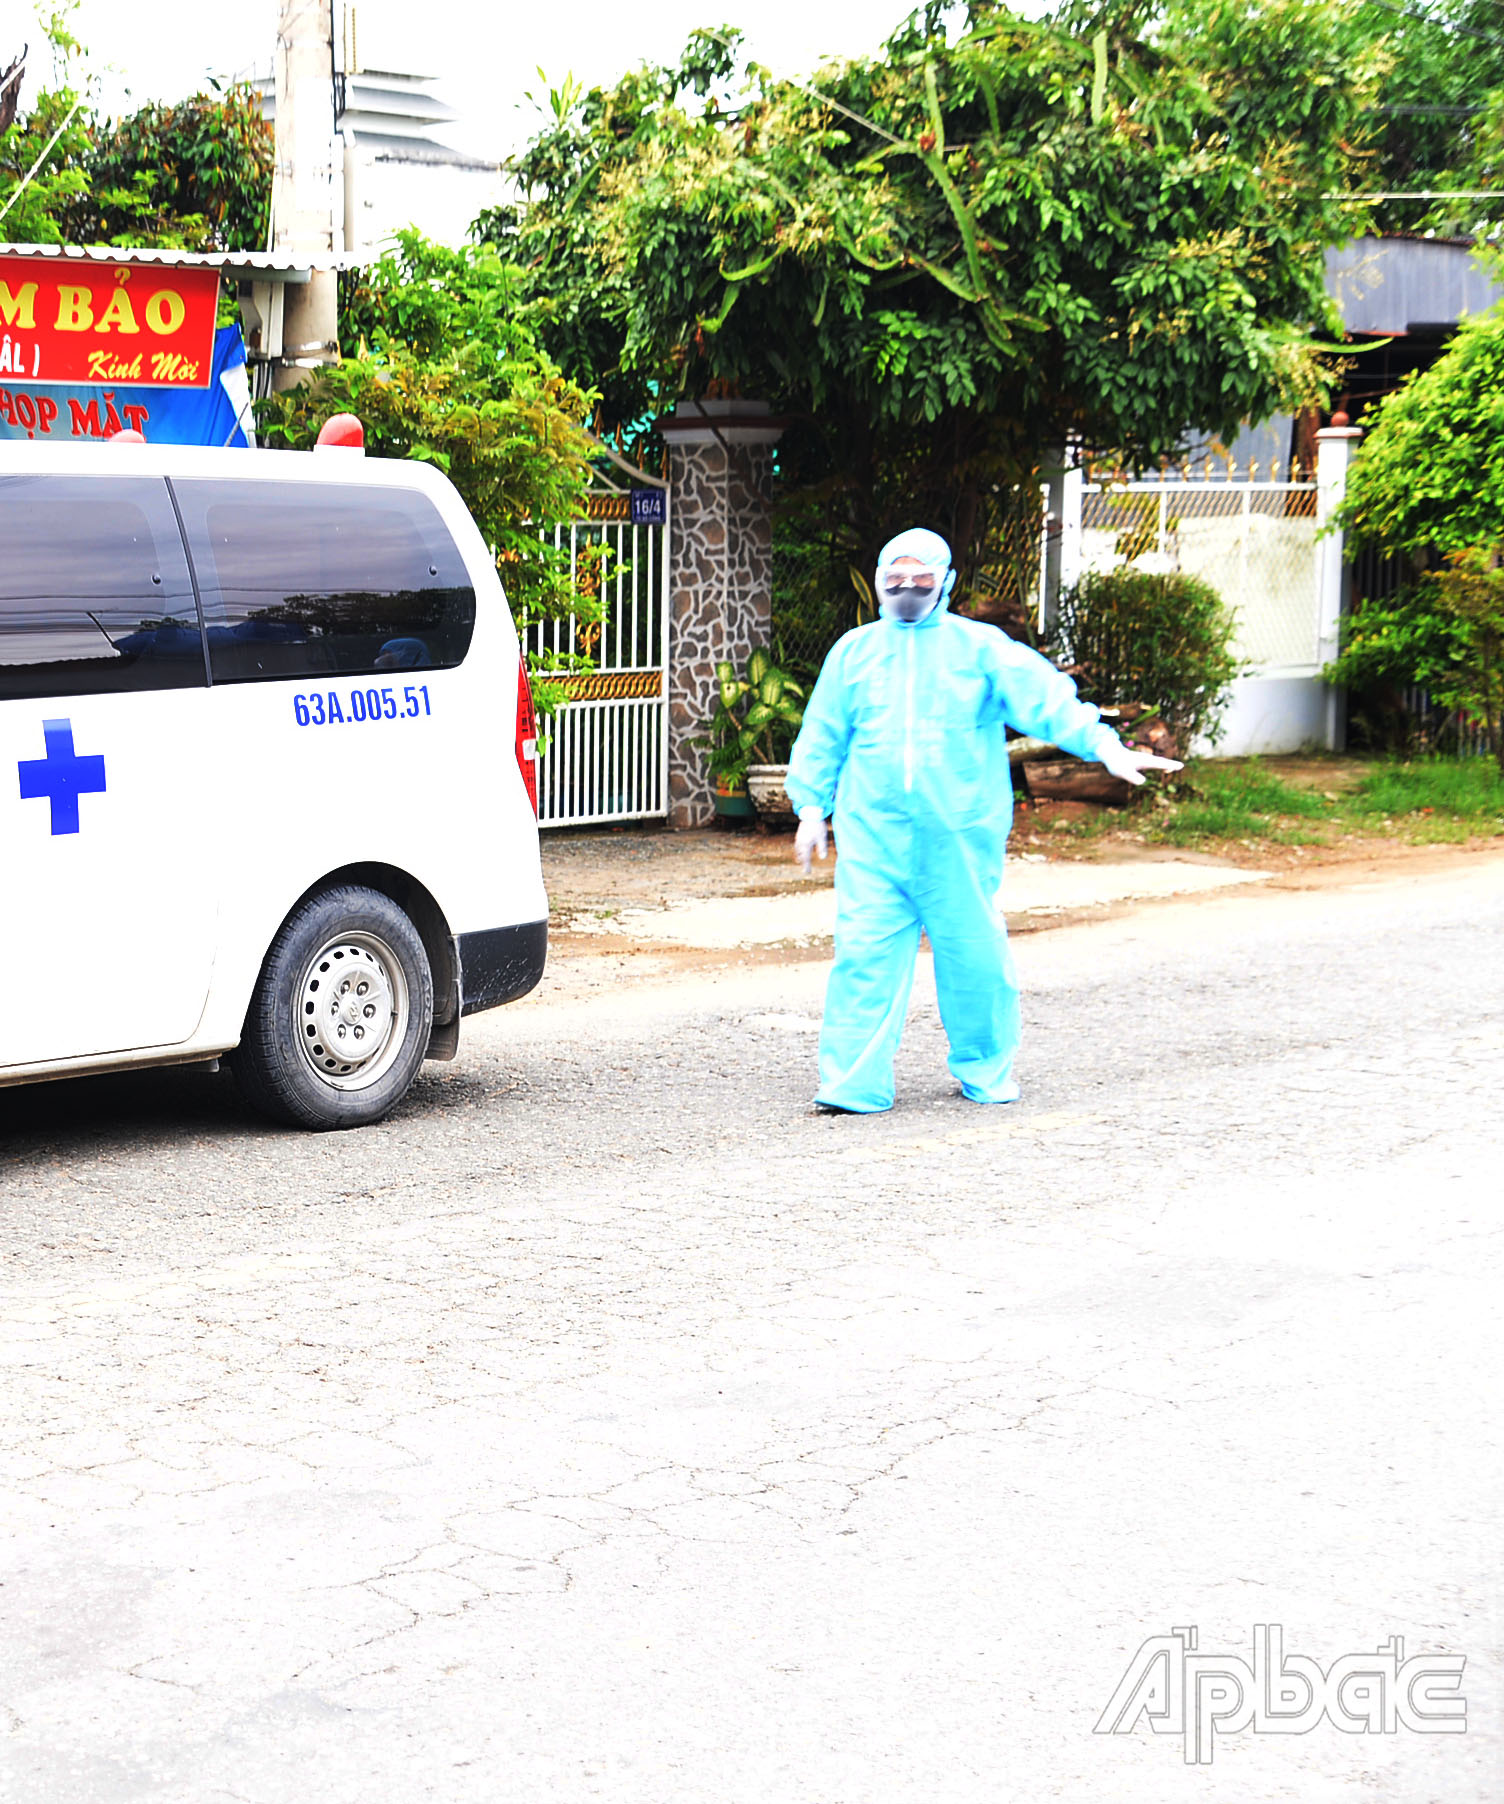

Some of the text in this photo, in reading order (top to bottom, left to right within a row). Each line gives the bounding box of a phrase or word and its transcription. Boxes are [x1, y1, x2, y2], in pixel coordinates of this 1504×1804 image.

[53, 267, 186, 335] BẢO
[87, 350, 201, 382] Kính Mời
[635, 498, 662, 516] 16/4
[293, 685, 432, 727] 63A.005.51
